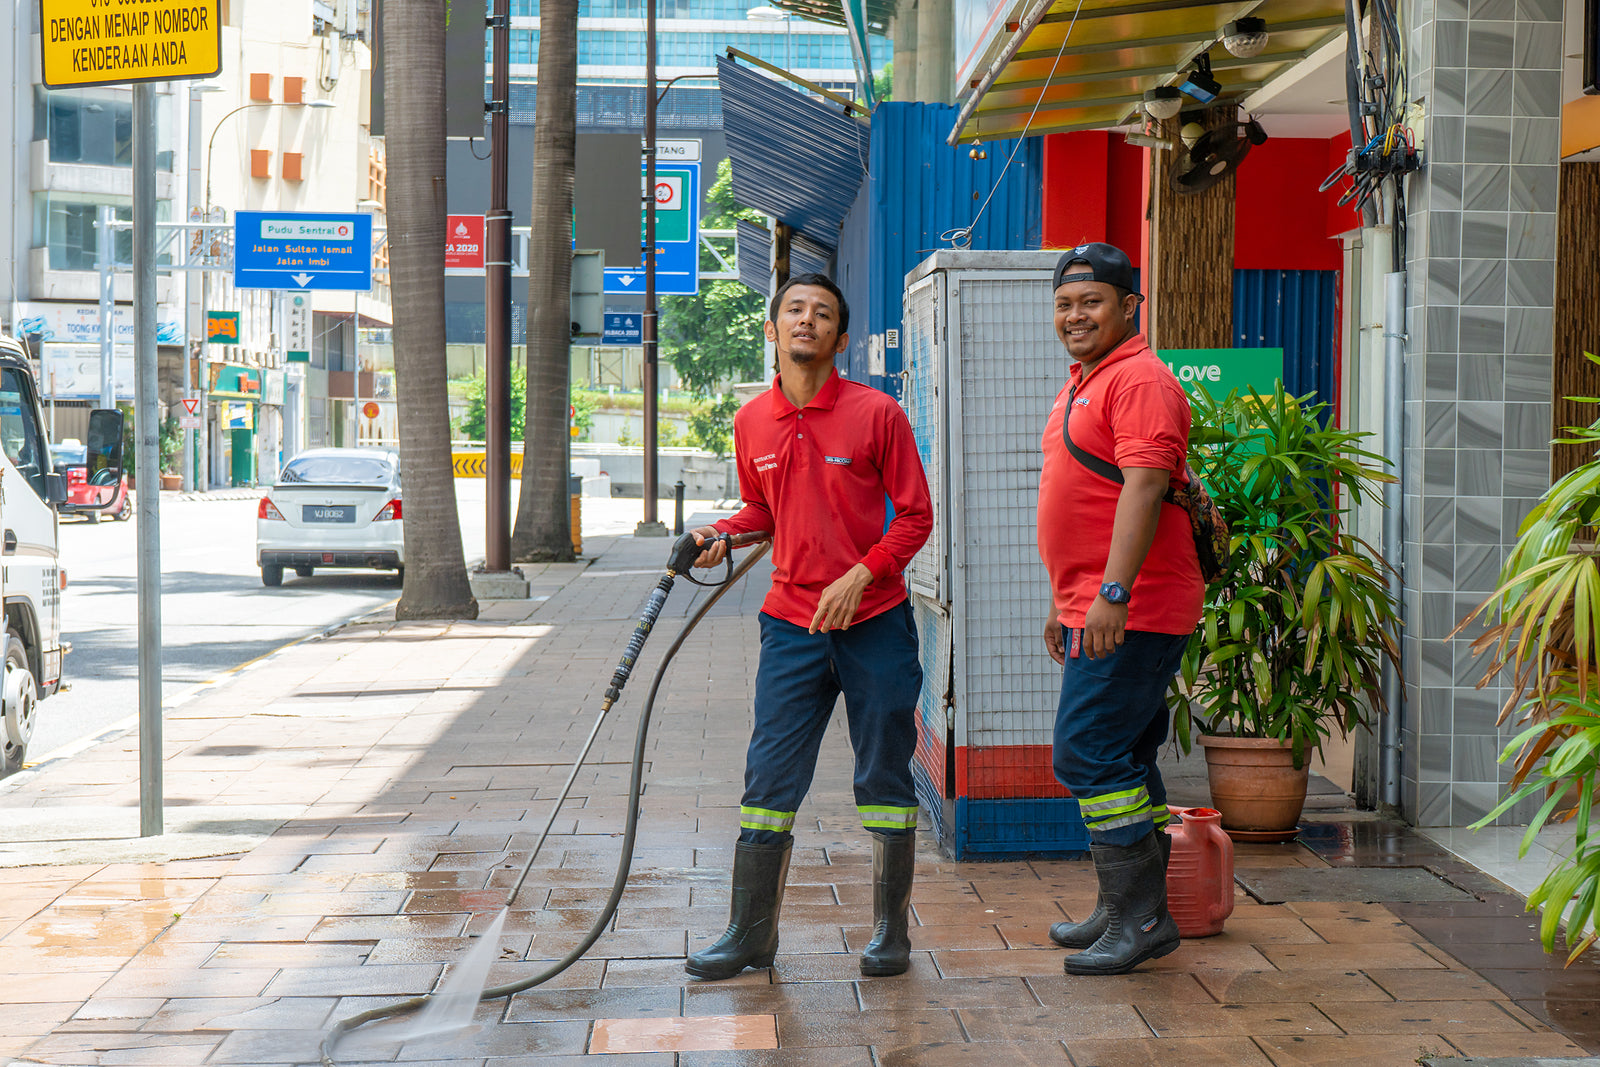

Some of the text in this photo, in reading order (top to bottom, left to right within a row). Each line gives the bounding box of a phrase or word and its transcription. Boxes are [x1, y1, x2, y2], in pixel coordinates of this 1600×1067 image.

[50, 6, 209, 43] DENGAN MENAIP NOMBOR
[72, 40, 188, 73] KENDERAAN ANDA
[656, 146, 686, 155] TANG
[268, 225, 336, 236] Pudu Sentral
[252, 244, 353, 255] Jalan Sultan Ismail
[456, 243, 479, 253] 2020
[276, 257, 331, 267] Jalan Imbi
[67, 322, 91, 334] TOONG
[1168, 361, 1222, 382] Love
